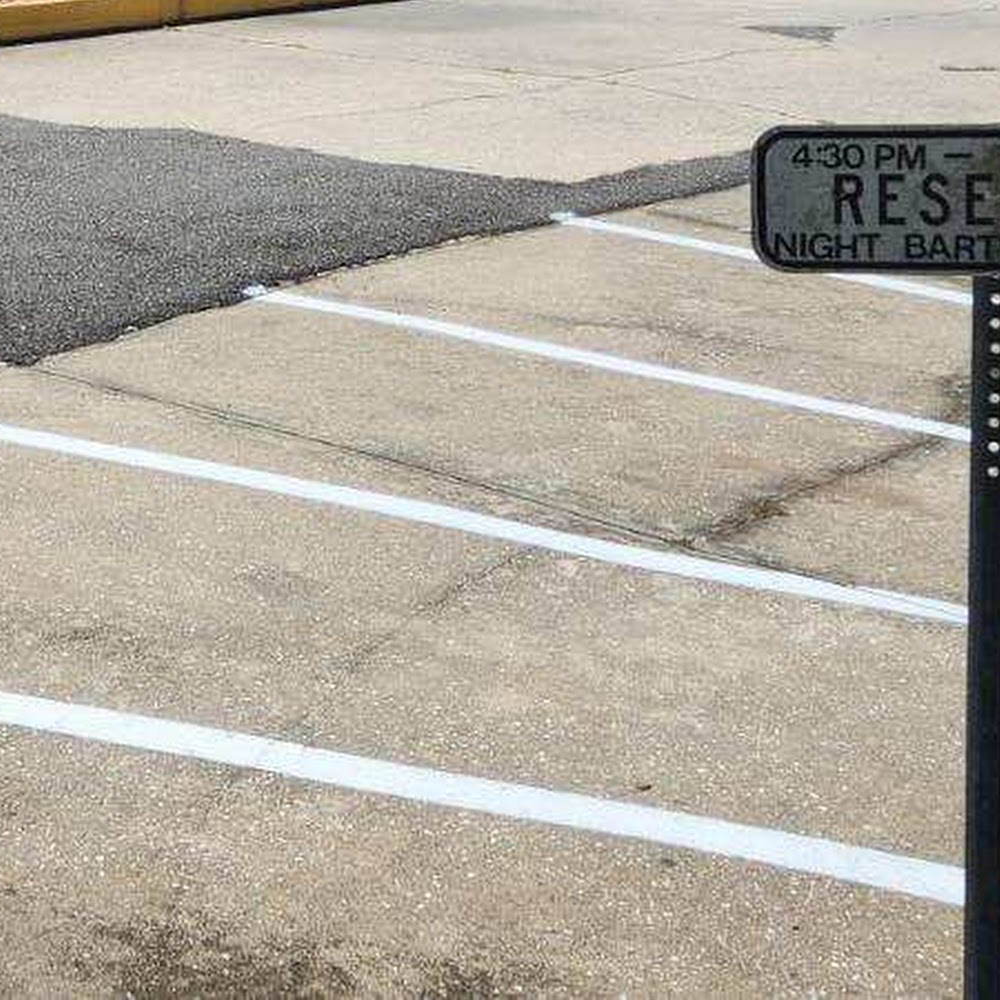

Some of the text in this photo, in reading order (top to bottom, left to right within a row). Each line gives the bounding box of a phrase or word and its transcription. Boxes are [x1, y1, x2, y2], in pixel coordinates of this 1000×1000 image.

[792, 143, 865, 169] 4:30
[874, 144, 927, 170] PM
[832, 172, 996, 227] RESE
[775, 232, 1000, 261] NIGHT BART
